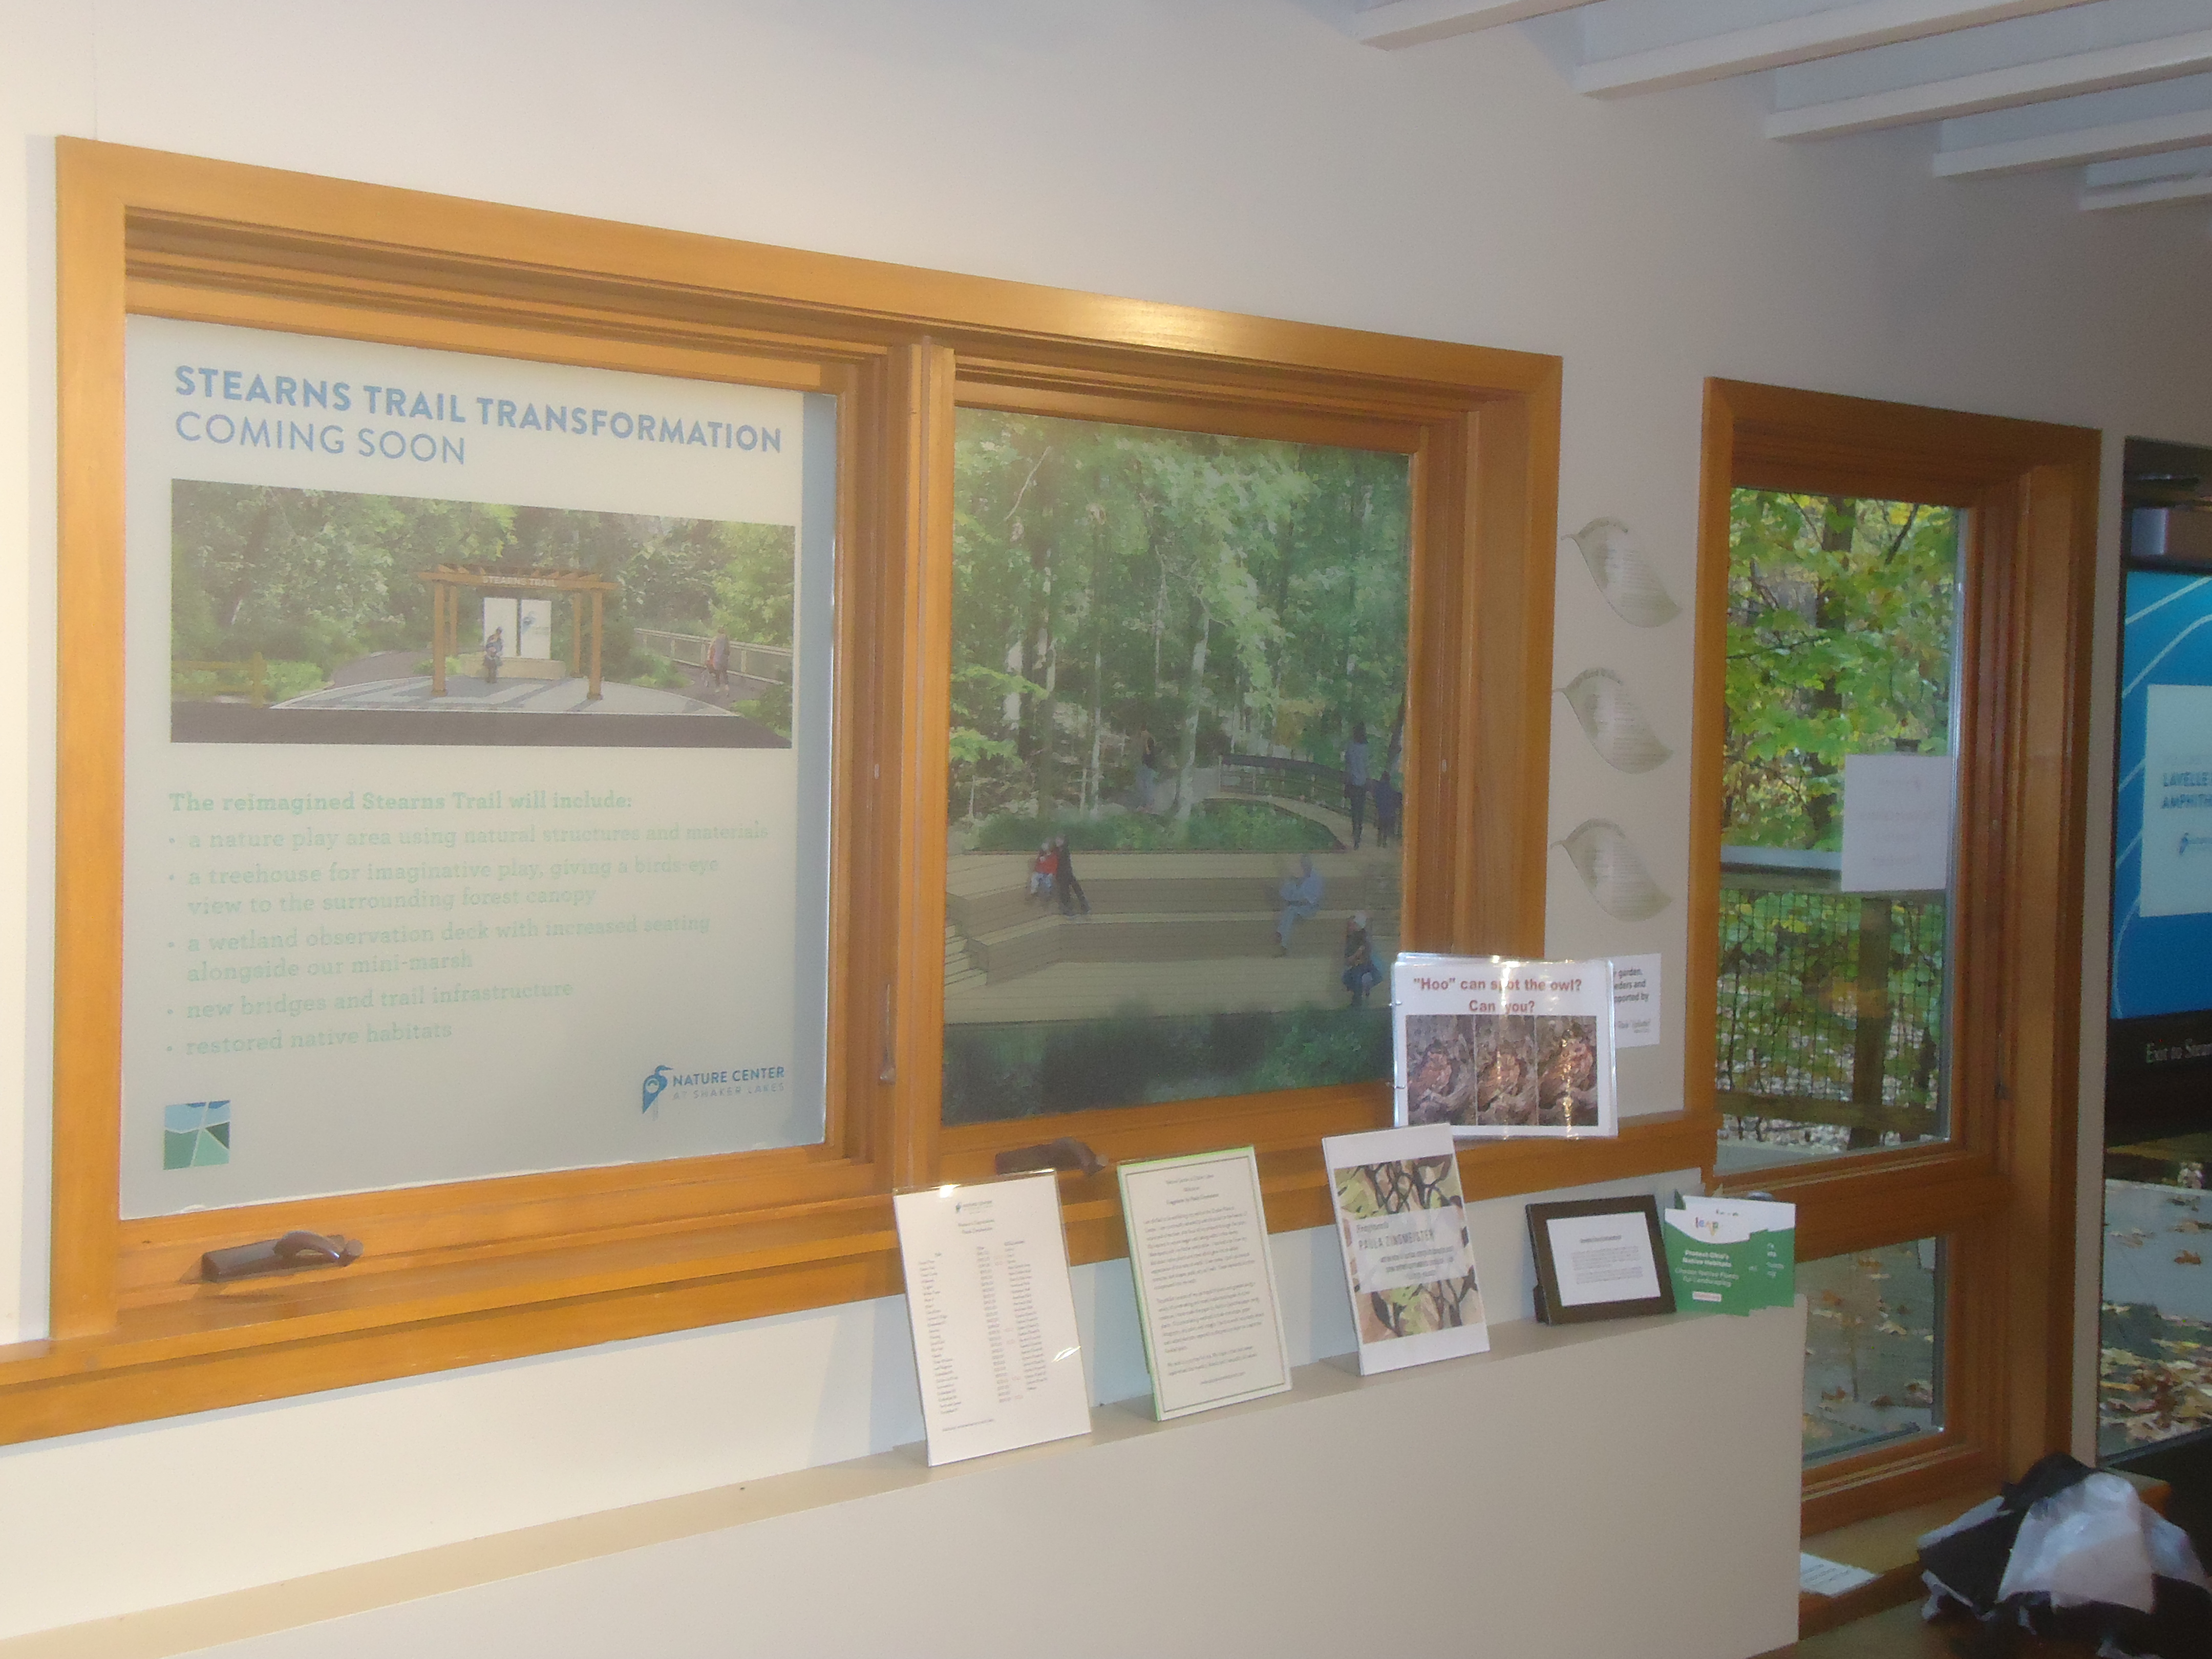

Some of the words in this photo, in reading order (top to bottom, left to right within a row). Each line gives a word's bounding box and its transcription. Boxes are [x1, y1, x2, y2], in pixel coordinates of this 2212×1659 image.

[176, 365, 352, 411] STEARNS
[363, 385, 466, 423] TRAIL
[476, 397, 782, 454] TRANSFORMATION
[176, 411, 345, 454] COMING
[357, 428, 465, 465] SOON
[169, 791, 215, 811] The
[222, 791, 356, 815] reimagined
[362, 792, 445, 810] Stearns
[452, 790, 502, 810] Trail
[509, 790, 547, 809] will
[552, 790, 632, 809] include:
[189, 834, 201, 848] a
[210, 832, 284, 848] nature
[292, 826, 339, 851] play
[347, 832, 392, 845] area
[399, 826, 457, 848] using
[465, 823, 536, 843] natural
[543, 827, 640, 842] structures
[646, 821, 680, 841] and
[687, 820, 769, 840] materials
[188, 871, 201, 885] a
[209, 863, 323, 884] treehouse
[329, 861, 360, 882] for
[367, 861, 492, 884] imaginative
[497, 857, 544, 881] play,
[550, 858, 613, 879] giving
[618, 861, 628, 874] a
[634, 854, 719, 876] birds-eye
[187, 896, 243, 915] view
[250, 898, 272, 913] to
[279, 892, 315, 912] the
[323, 888, 455, 911] surrounding
[462, 886, 520, 906] forest
[526, 889, 597, 906] canopy
[188, 938, 200, 951] a
[209, 926, 297, 950] wetland
[306, 925, 434, 947] observation
[441, 922, 490, 941] deck
[495, 918, 539, 939] with
[546, 914, 638, 936] increased
[644, 914, 711, 934] seating
[187, 957, 300, 984] alongside
[307, 962, 344, 975] our
[351, 948, 473, 973] mini-marsh
[1414, 977, 1456, 991] "Hoo"
[1460, 980, 1486, 990] can
[1524, 978, 1546, 991] the
[1550, 978, 1582, 992] owl?
[1634, 979, 1646, 988] and
[187, 1003, 233, 1018] new
[241, 993, 327, 1017] bridges
[334, 988, 374, 1010] and
[380, 985, 426, 1007] trail
[433, 983, 574, 1004] infrastructure
[1469, 999, 1496, 1012] Can
[1505, 1000, 1535, 1015] you?
[186, 1029, 283, 1055] restored
[290, 1029, 359, 1048] native
[367, 1022, 452, 1043] habitats
[673, 1071, 728, 1087] NATURE
[732, 1066, 785, 1082] CENTER
